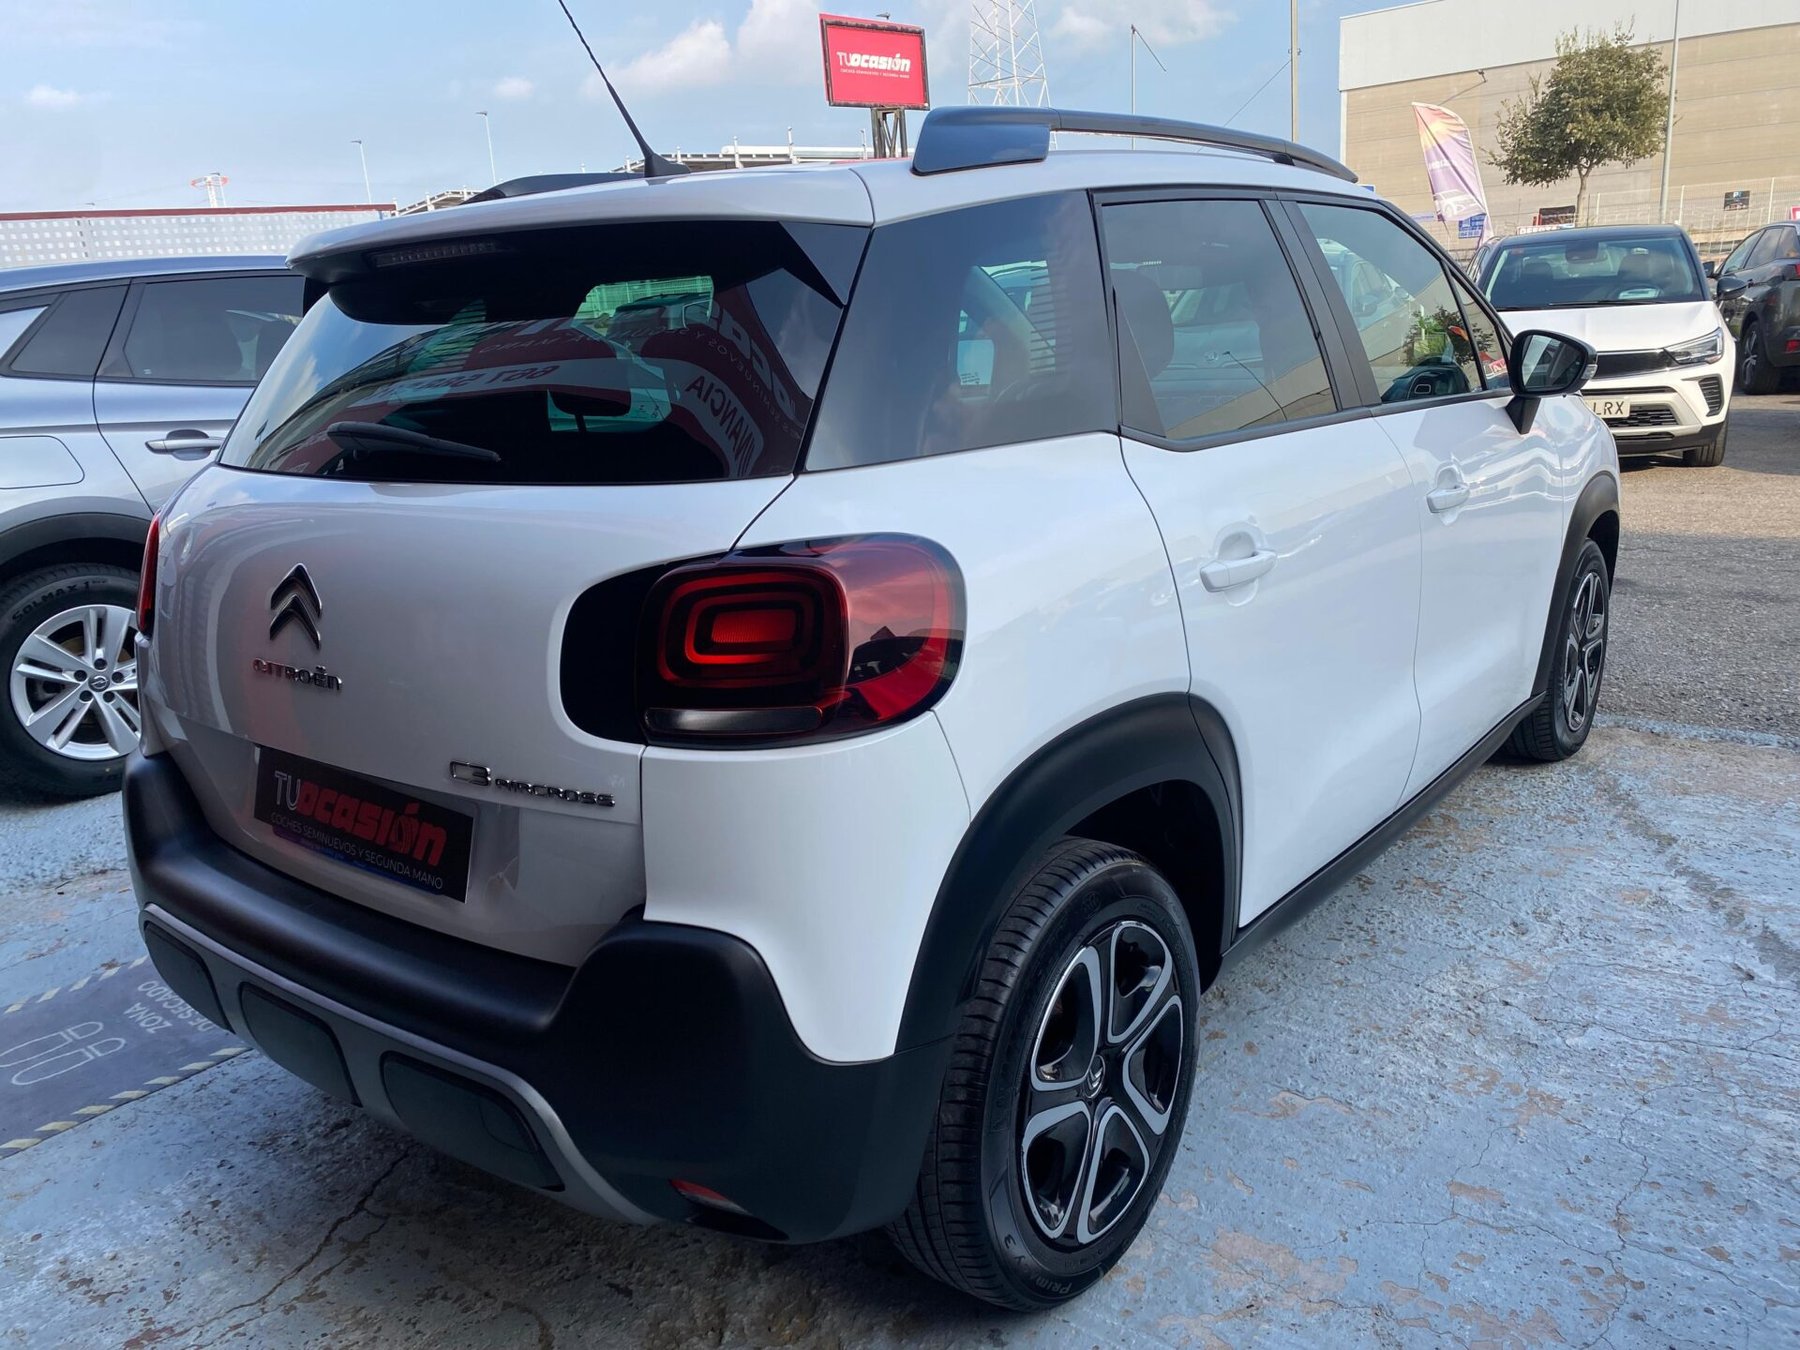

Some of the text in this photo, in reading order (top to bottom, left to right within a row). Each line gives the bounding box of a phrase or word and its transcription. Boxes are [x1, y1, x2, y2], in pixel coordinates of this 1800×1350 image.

[1593, 401, 1624, 415] LRX
[495, 779, 615, 807] AIRCROSS
[270, 811, 302, 834] COCHES
[303, 822, 358, 857] SEMINUEVOS
[364, 850, 411, 878] SEGUNDA
[412, 870, 443, 889] MANO
[138, 980, 196, 1019] SECADO
[124, 1002, 173, 1034] ZONA
